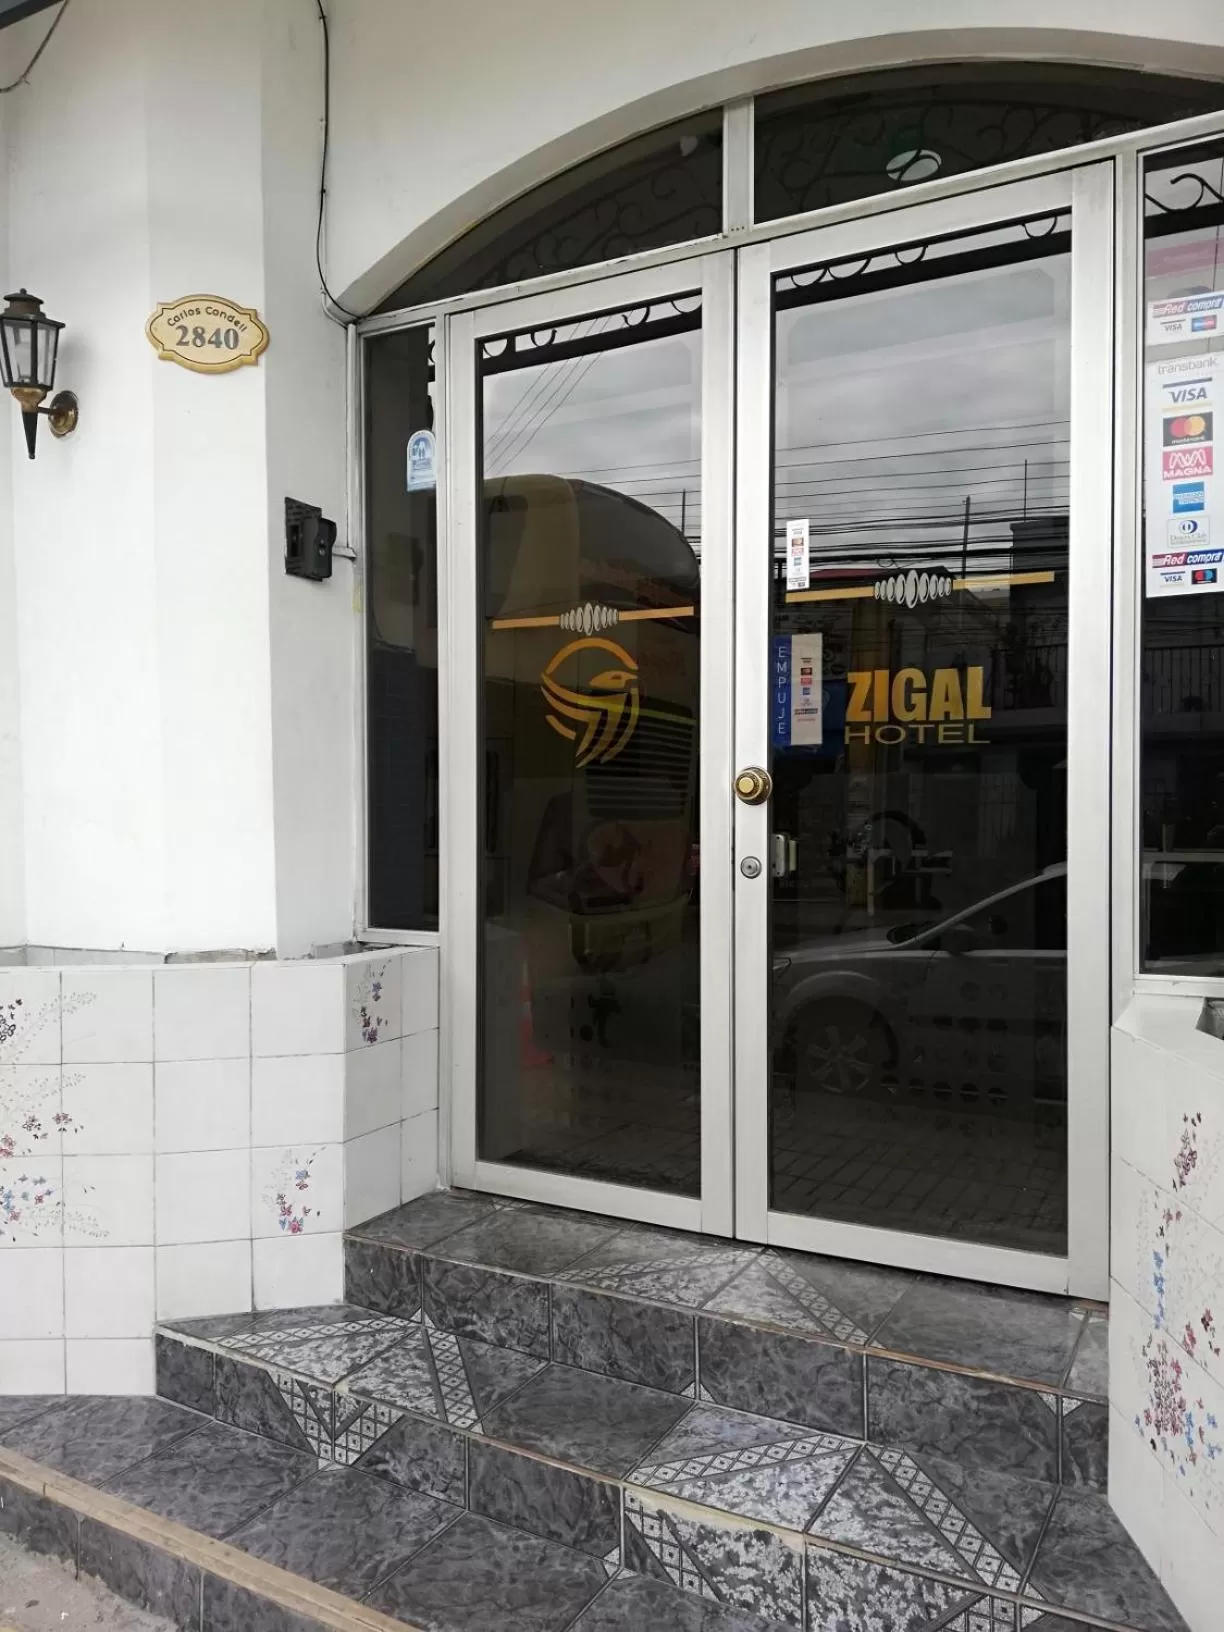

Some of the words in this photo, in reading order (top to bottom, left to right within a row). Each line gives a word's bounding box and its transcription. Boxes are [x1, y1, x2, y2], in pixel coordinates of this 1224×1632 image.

[167, 307, 201, 327] Carlos
[205, 306, 248, 333] Condell
[1164, 323, 1183, 333] VISA
[175, 325, 239, 350] 2840
[1168, 387, 1208, 403] VISA
[1163, 465, 1212, 479] MAGNA
[1163, 554, 1186, 566] Red
[1187, 551, 1222, 564] compra
[1164, 575, 1183, 583] VISA
[777, 646, 788, 735] EMPUJE
[845, 666, 992, 722] ZIGAL
[844, 723, 991, 745] HOTEL
